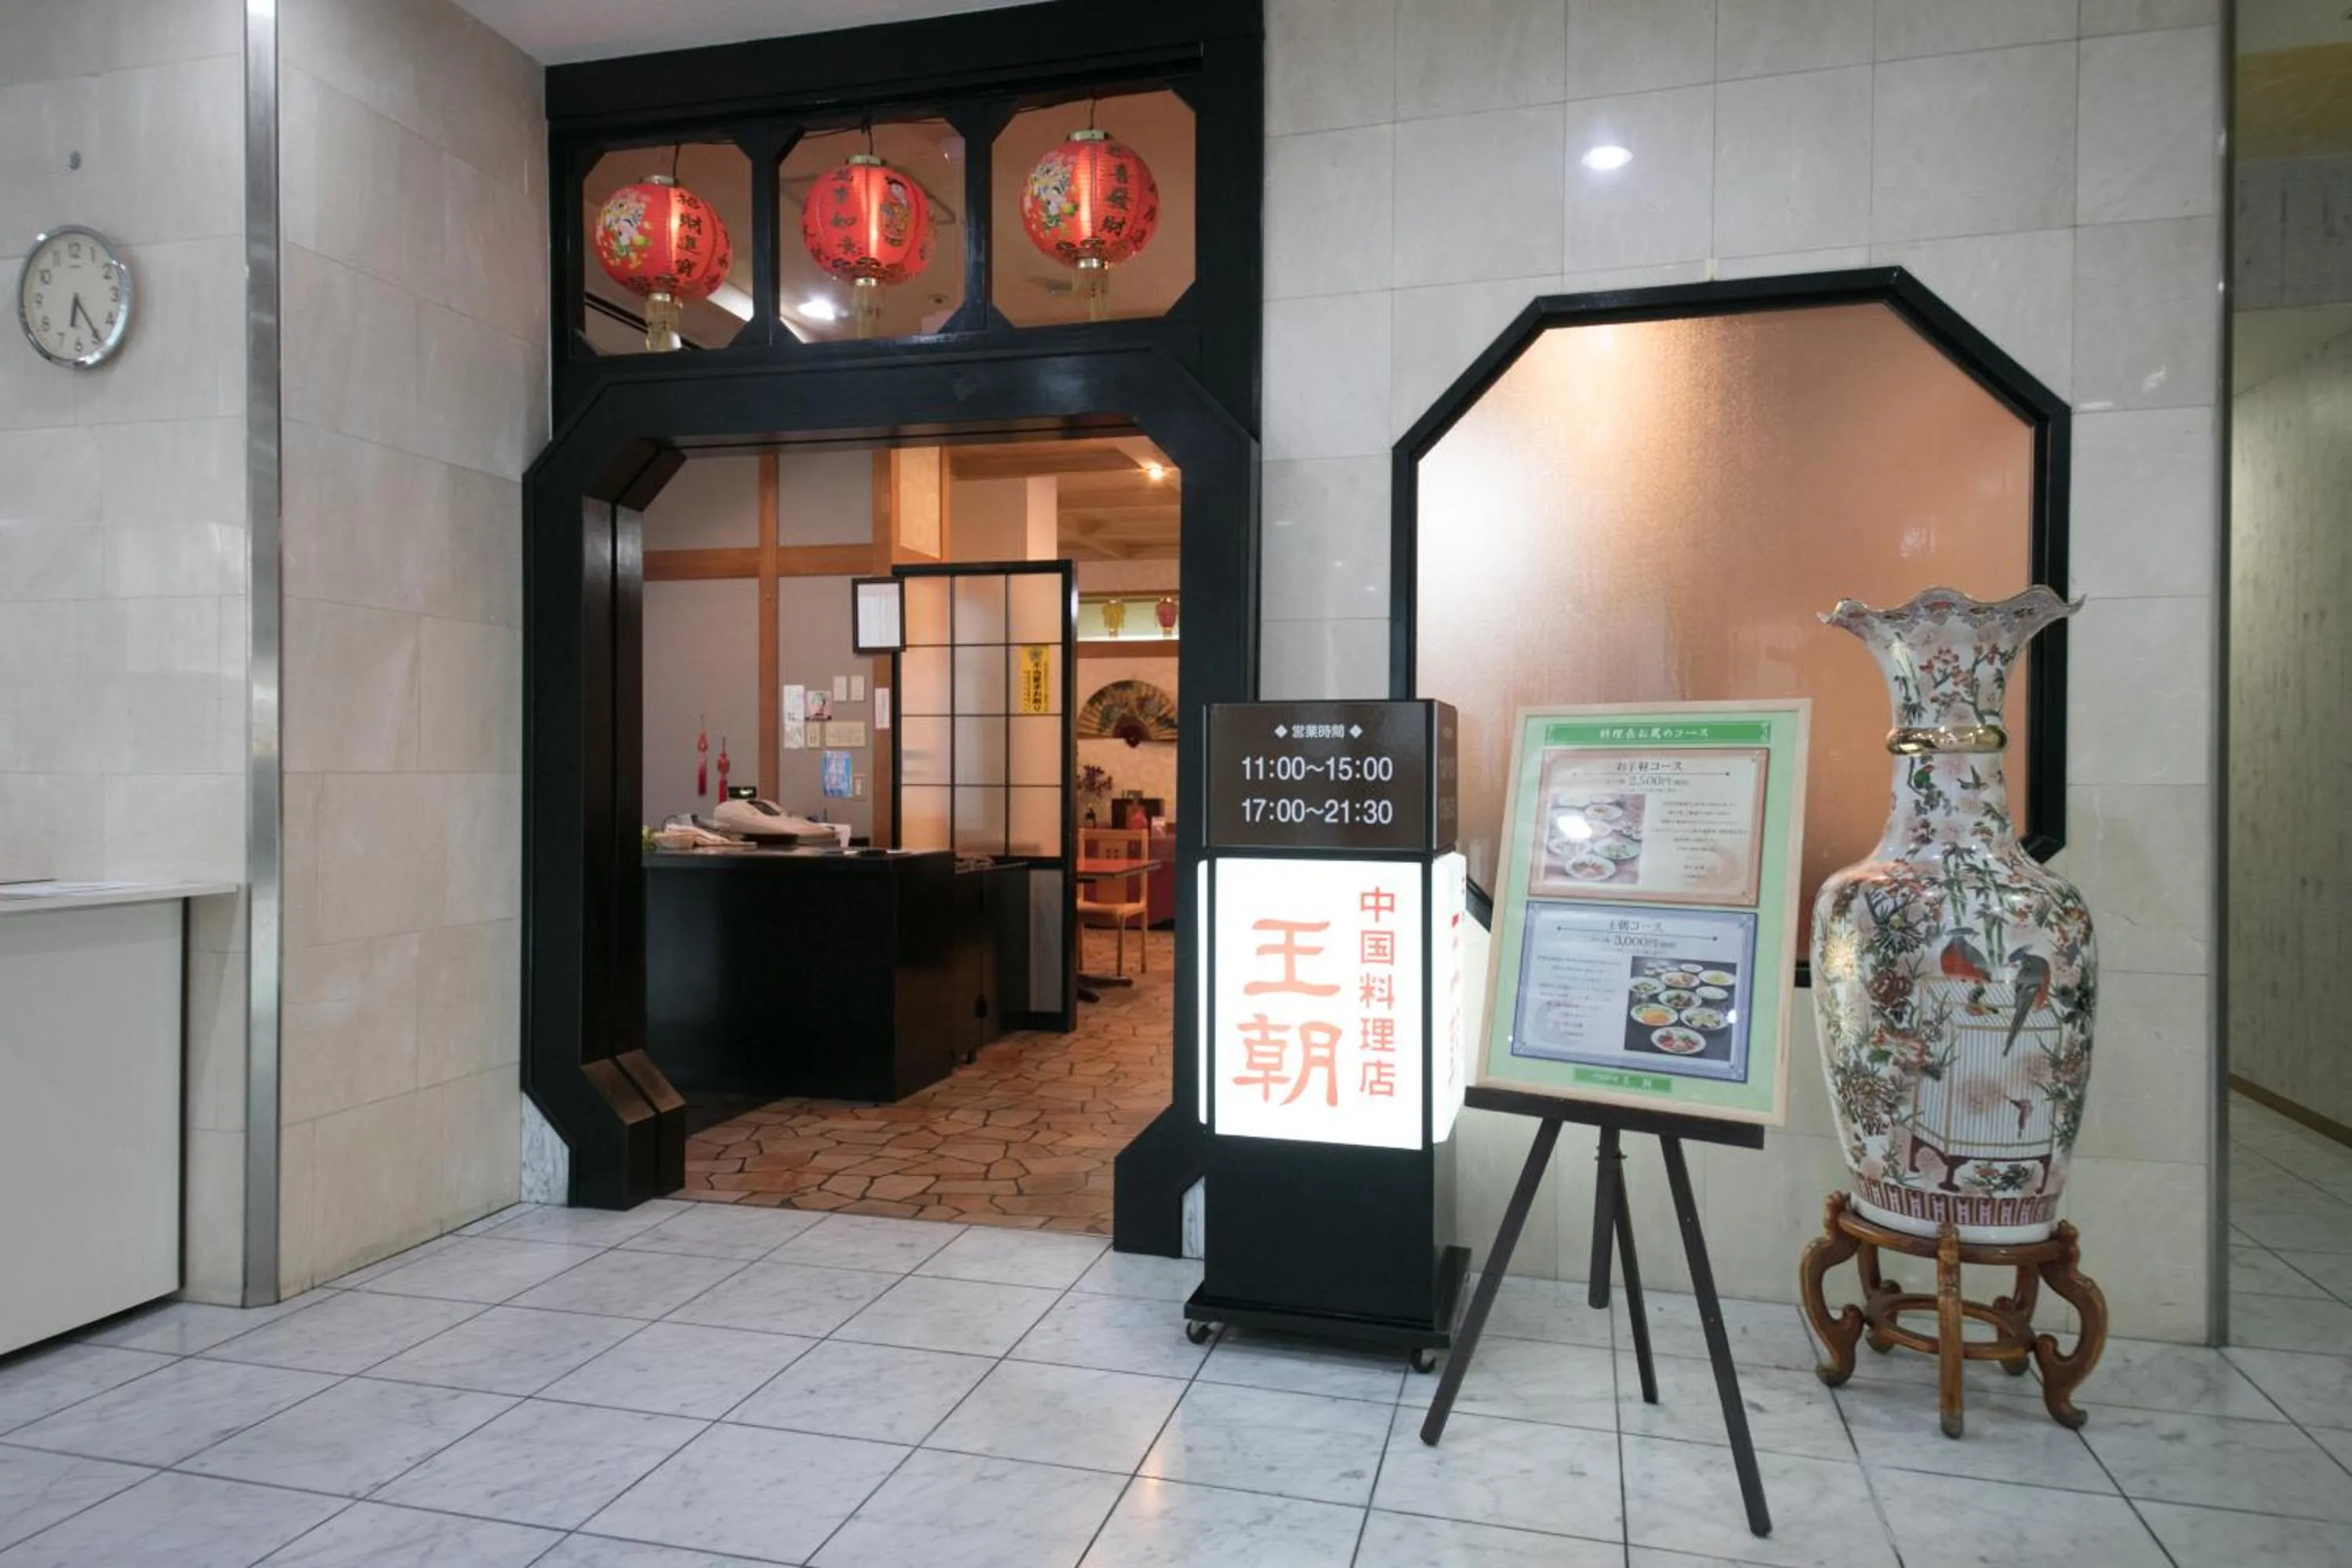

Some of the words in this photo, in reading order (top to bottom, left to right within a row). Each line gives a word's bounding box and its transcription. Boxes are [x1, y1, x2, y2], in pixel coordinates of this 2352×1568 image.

[67, 242, 81, 259] 12
[39, 269, 52, 285] 10
[102, 263, 113, 280] 2
[111, 287, 119, 303] 3
[105, 311, 114, 326] 4
[75, 337, 84, 353] 6
[1292, 724, 1345, 739] 営業時間
[1242, 756, 1393, 781] 11:00～15:00
[1242, 798, 1393, 823] 17:00～21:30
[1359, 886, 1396, 1098] 中国料理店
[1232, 918, 1343, 1107] 王朝
